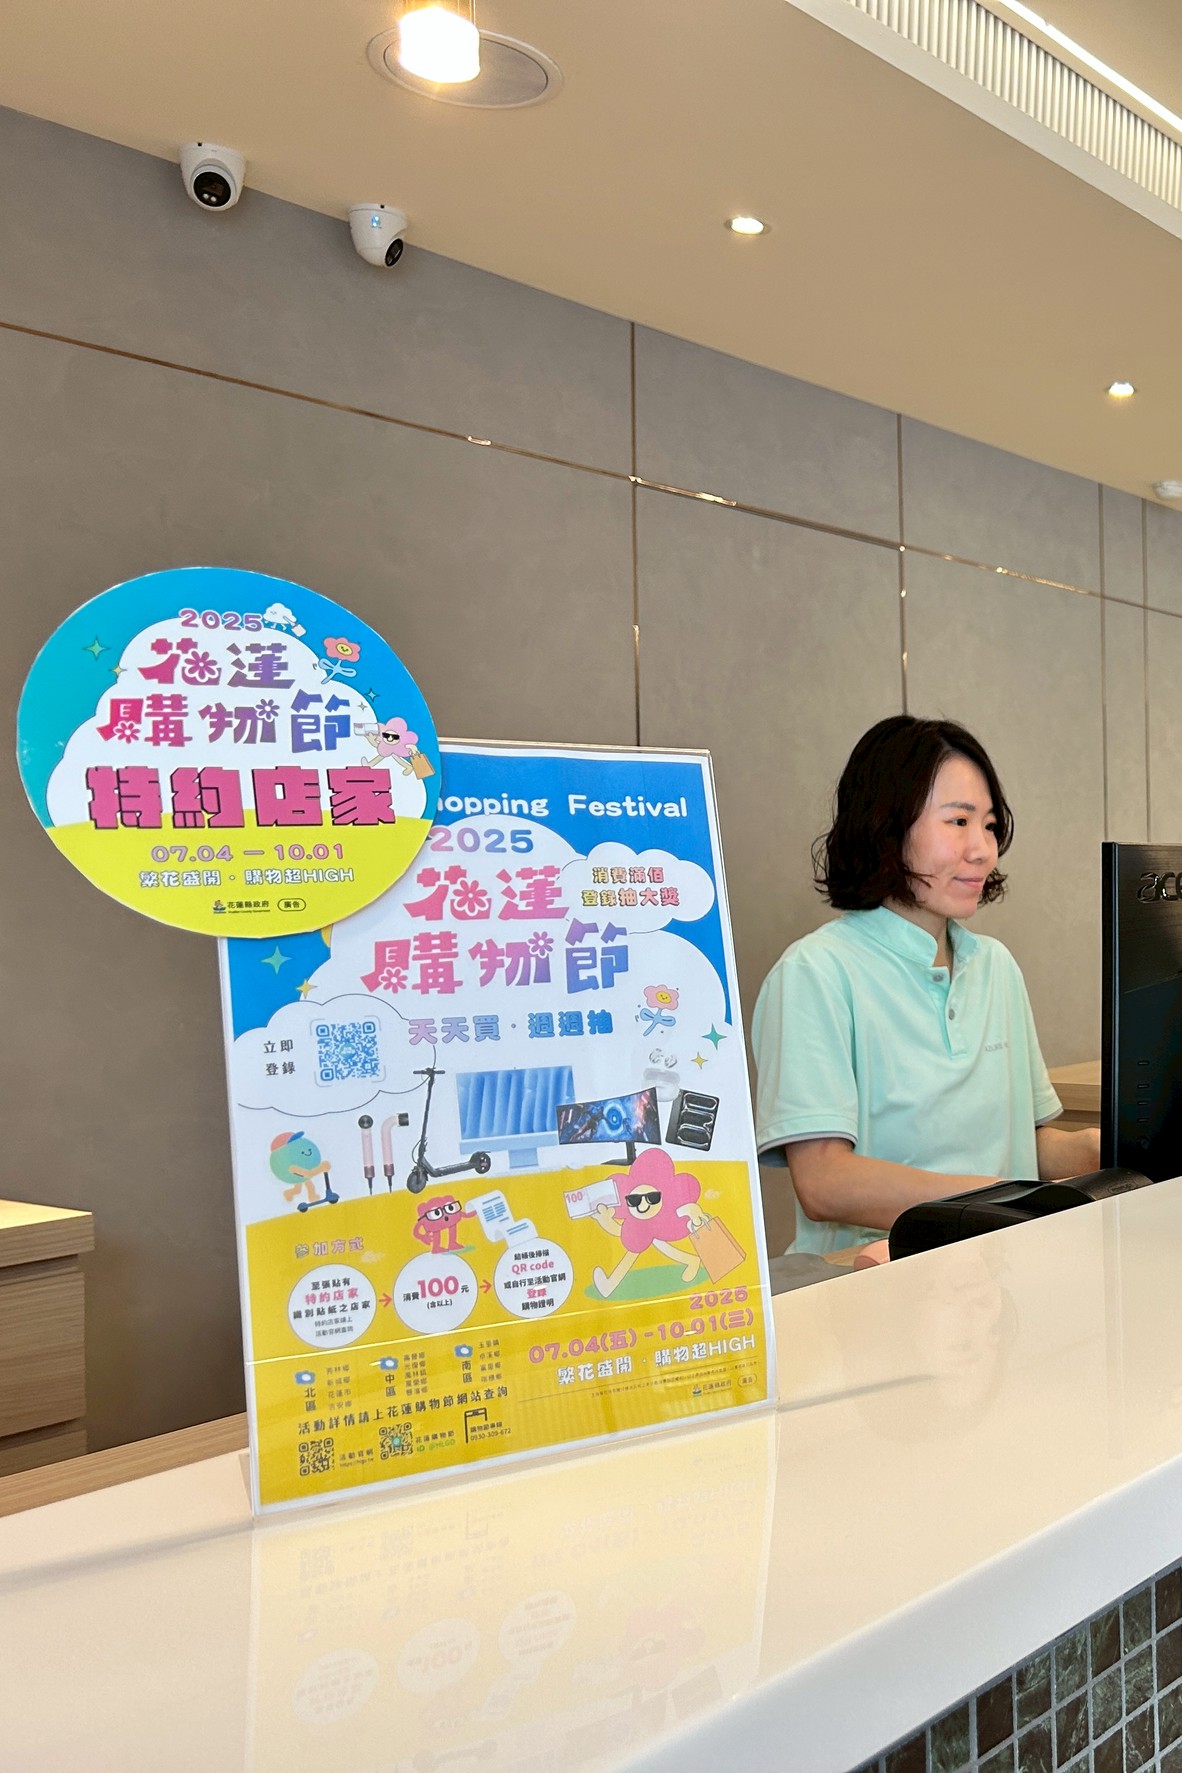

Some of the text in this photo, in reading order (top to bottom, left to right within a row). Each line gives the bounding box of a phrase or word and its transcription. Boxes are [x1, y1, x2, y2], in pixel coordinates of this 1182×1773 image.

[179, 608, 263, 632] 2025
[138, 637, 296, 689] 花蓮
[96, 689, 352, 754] 購物節
[85, 765, 397, 829] 特約店家
[567, 793, 688, 818] Festival
[429, 827, 534, 853] 2025
[151, 844, 233, 864] 07.04
[274, 842, 345, 861] 10.01
[592, 866, 665, 885] 消費滿佰
[402, 865, 570, 921] 花蓮
[581, 886, 680, 907] 登錄抽大獎
[360, 918, 629, 995] 購物節
[263, 1039, 294, 1054] 立即
[265, 1061, 296, 1077] 登錄
[565, 1192, 584, 1204] 100
[511, 1260, 555, 1275] QR code
[305, 1287, 359, 1306] 特約店家
[689, 1284, 749, 1310] 2025
[462, 1360, 472, 1383] 南區
